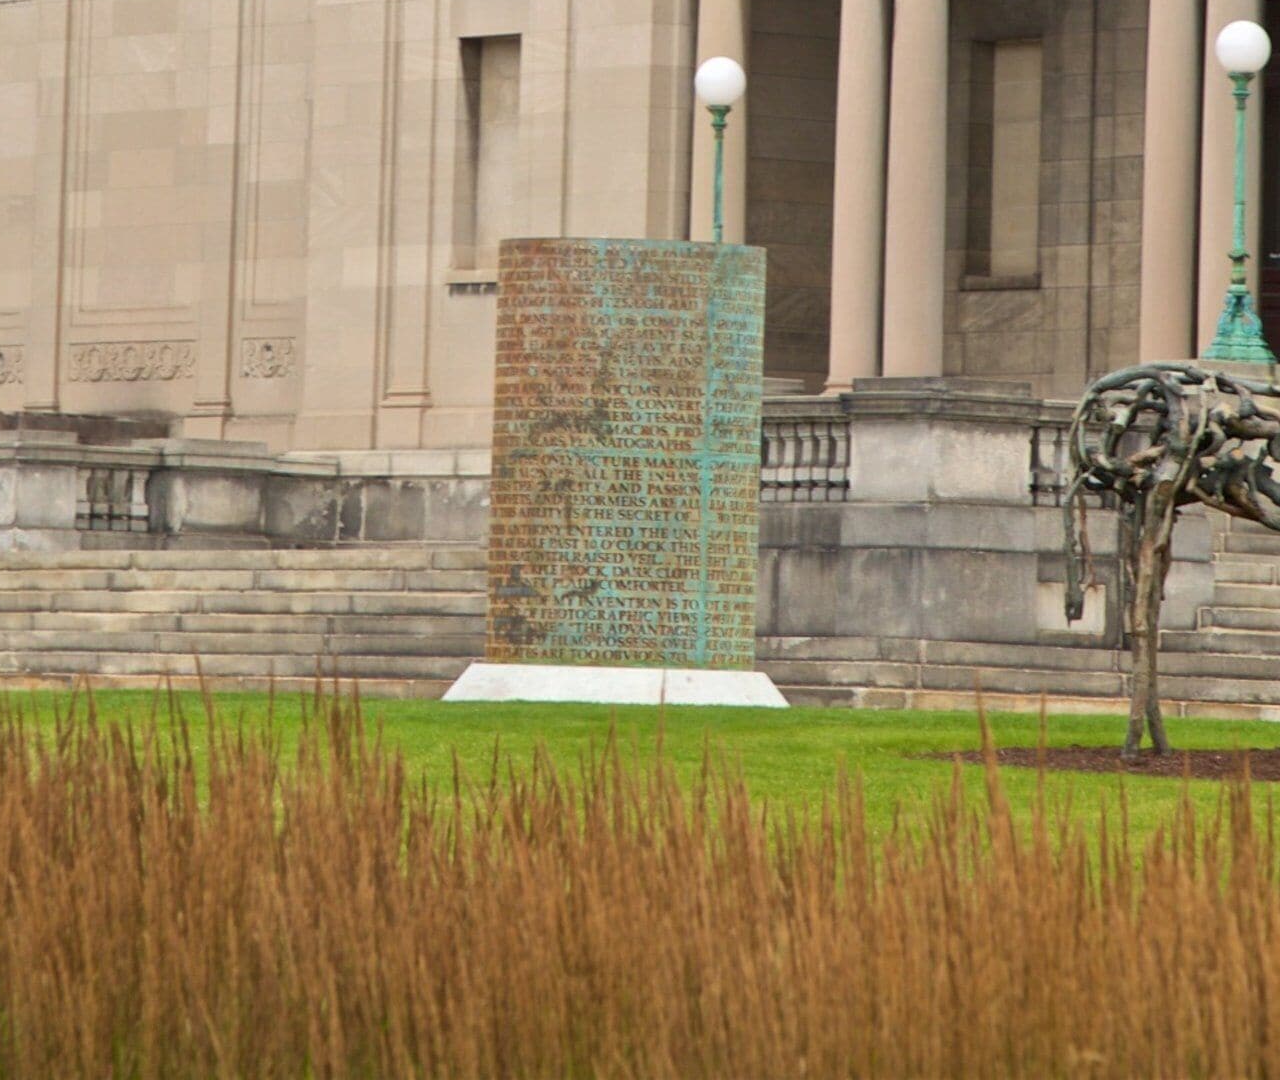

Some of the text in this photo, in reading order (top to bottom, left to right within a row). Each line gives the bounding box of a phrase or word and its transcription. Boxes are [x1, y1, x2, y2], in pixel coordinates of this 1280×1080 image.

[614, 469, 642, 481] THE
[607, 482, 642, 494] AND
[583, 508, 613, 519] THE
[618, 509, 672, 521] SECRET
[567, 526, 634, 538] ENTERED
[640, 527, 669, 539] THE
[671, 541, 701, 553] THIS
[577, 596, 661, 609] INVENTION
